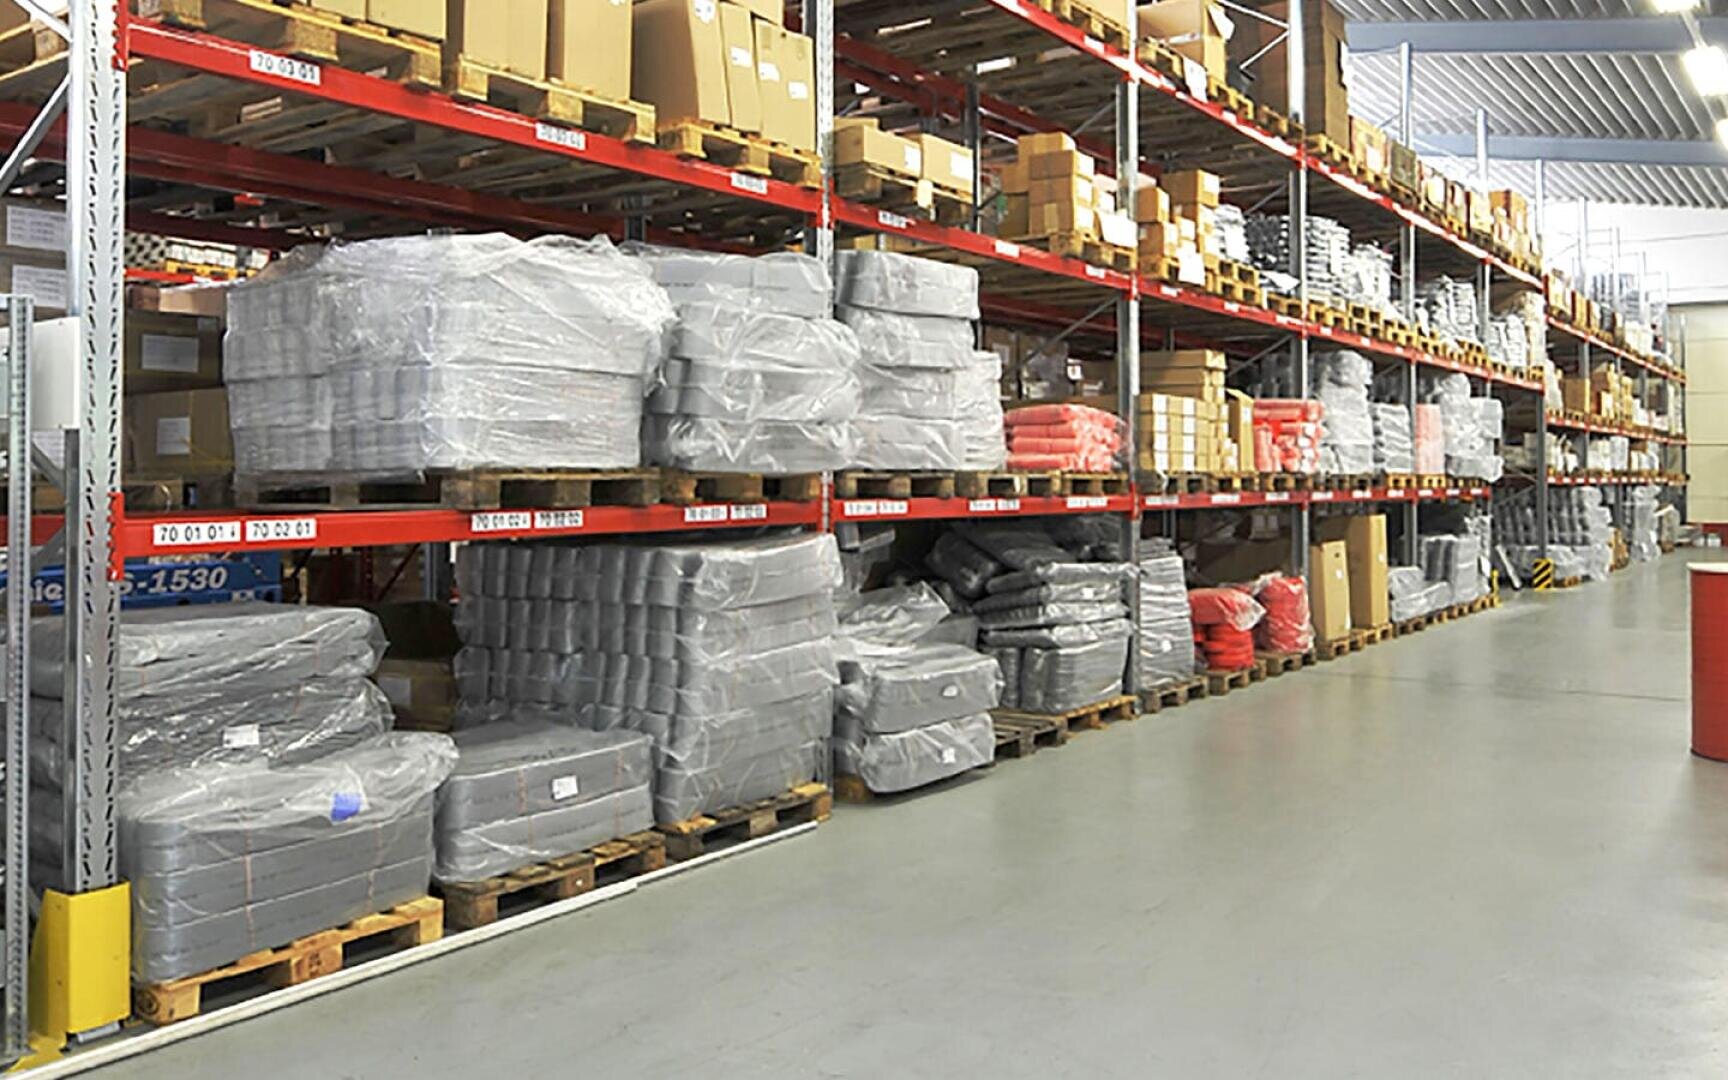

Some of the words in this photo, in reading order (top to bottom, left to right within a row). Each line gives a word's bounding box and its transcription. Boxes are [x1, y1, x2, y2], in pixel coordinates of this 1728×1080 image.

[256, 53, 274, 71] 70
[299, 63, 315, 80] 01
[160, 525, 179, 542] 70
[184, 525, 201, 542] 01
[207, 524, 224, 540] 01
[253, 522, 270, 538] 70
[274, 521, 290, 537] 02
[296, 521, 310, 536] 01
